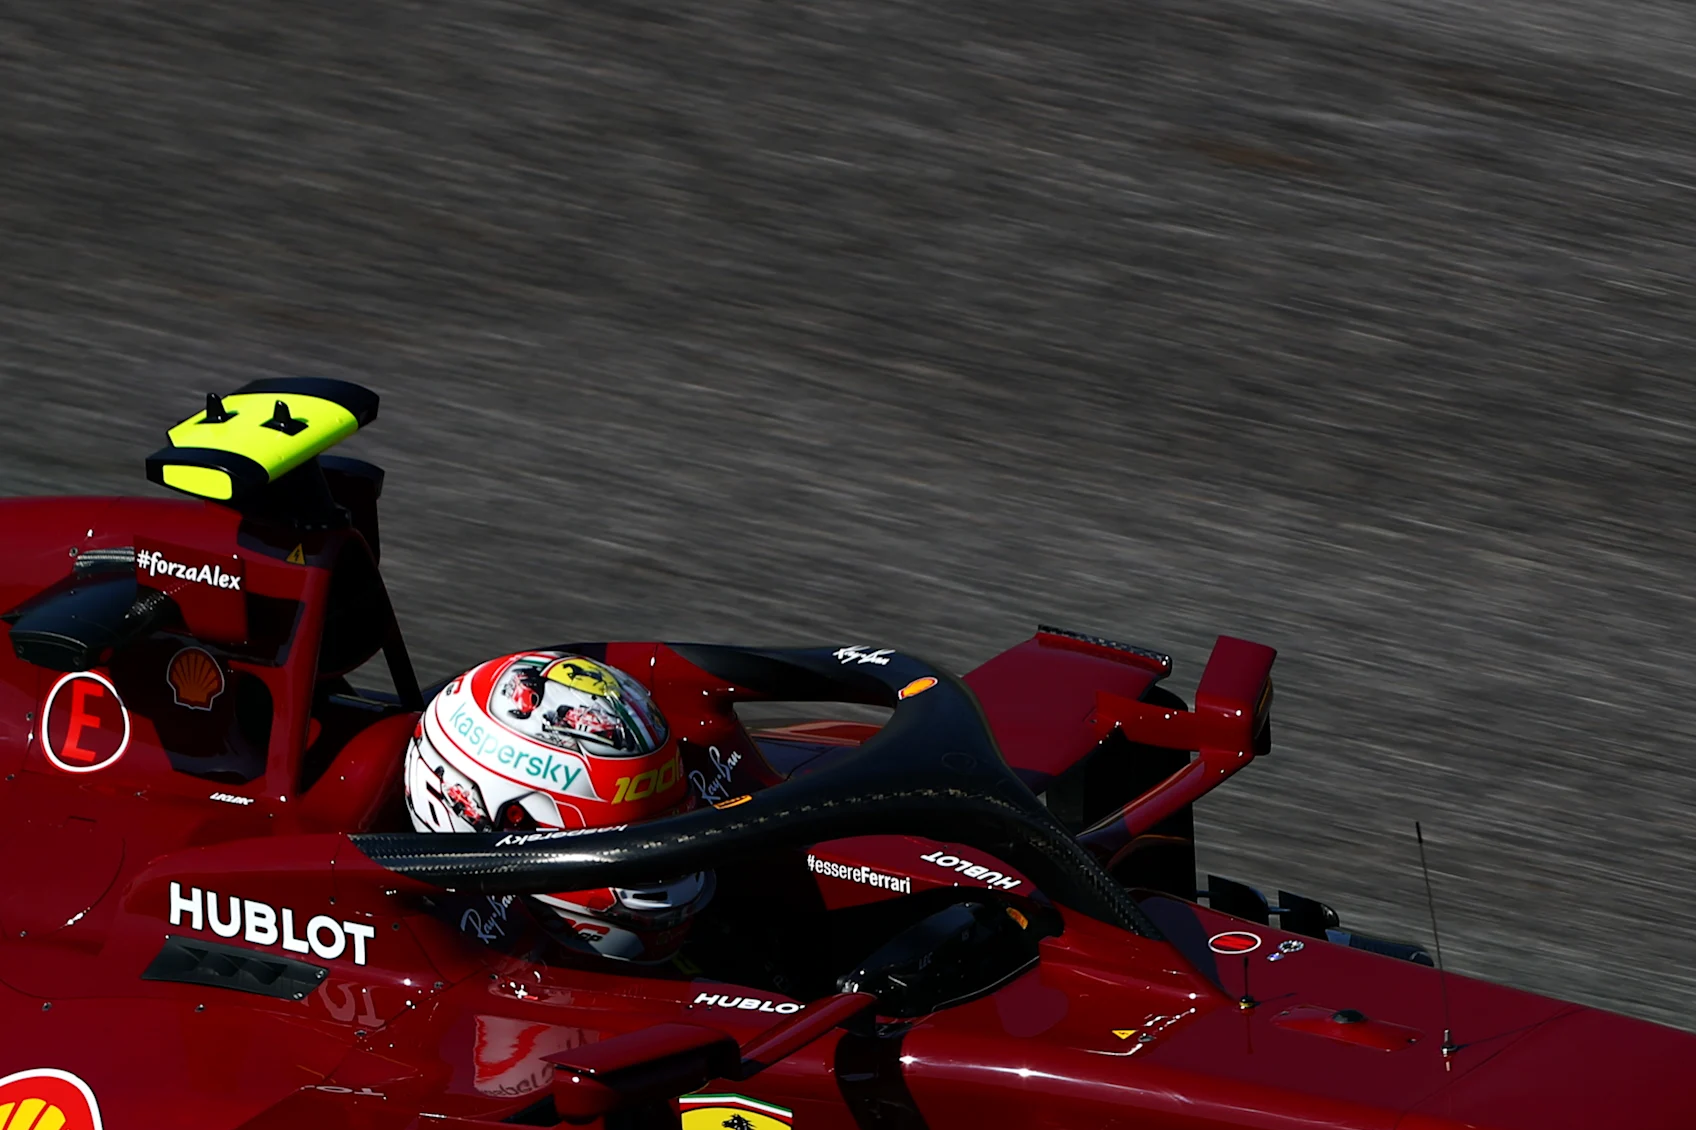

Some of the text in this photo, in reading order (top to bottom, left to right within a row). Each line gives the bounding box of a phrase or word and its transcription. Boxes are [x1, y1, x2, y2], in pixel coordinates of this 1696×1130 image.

[137, 549, 241, 591] #forzaAlex
[61, 679, 104, 762] E
[449, 702, 582, 791] kaspersky
[807, 854, 911, 895] #essereFerrari
[920, 851, 1022, 890] HUBLOT
[169, 881, 375, 966] HUBLOT
[693, 992, 806, 1014] HUBLO
